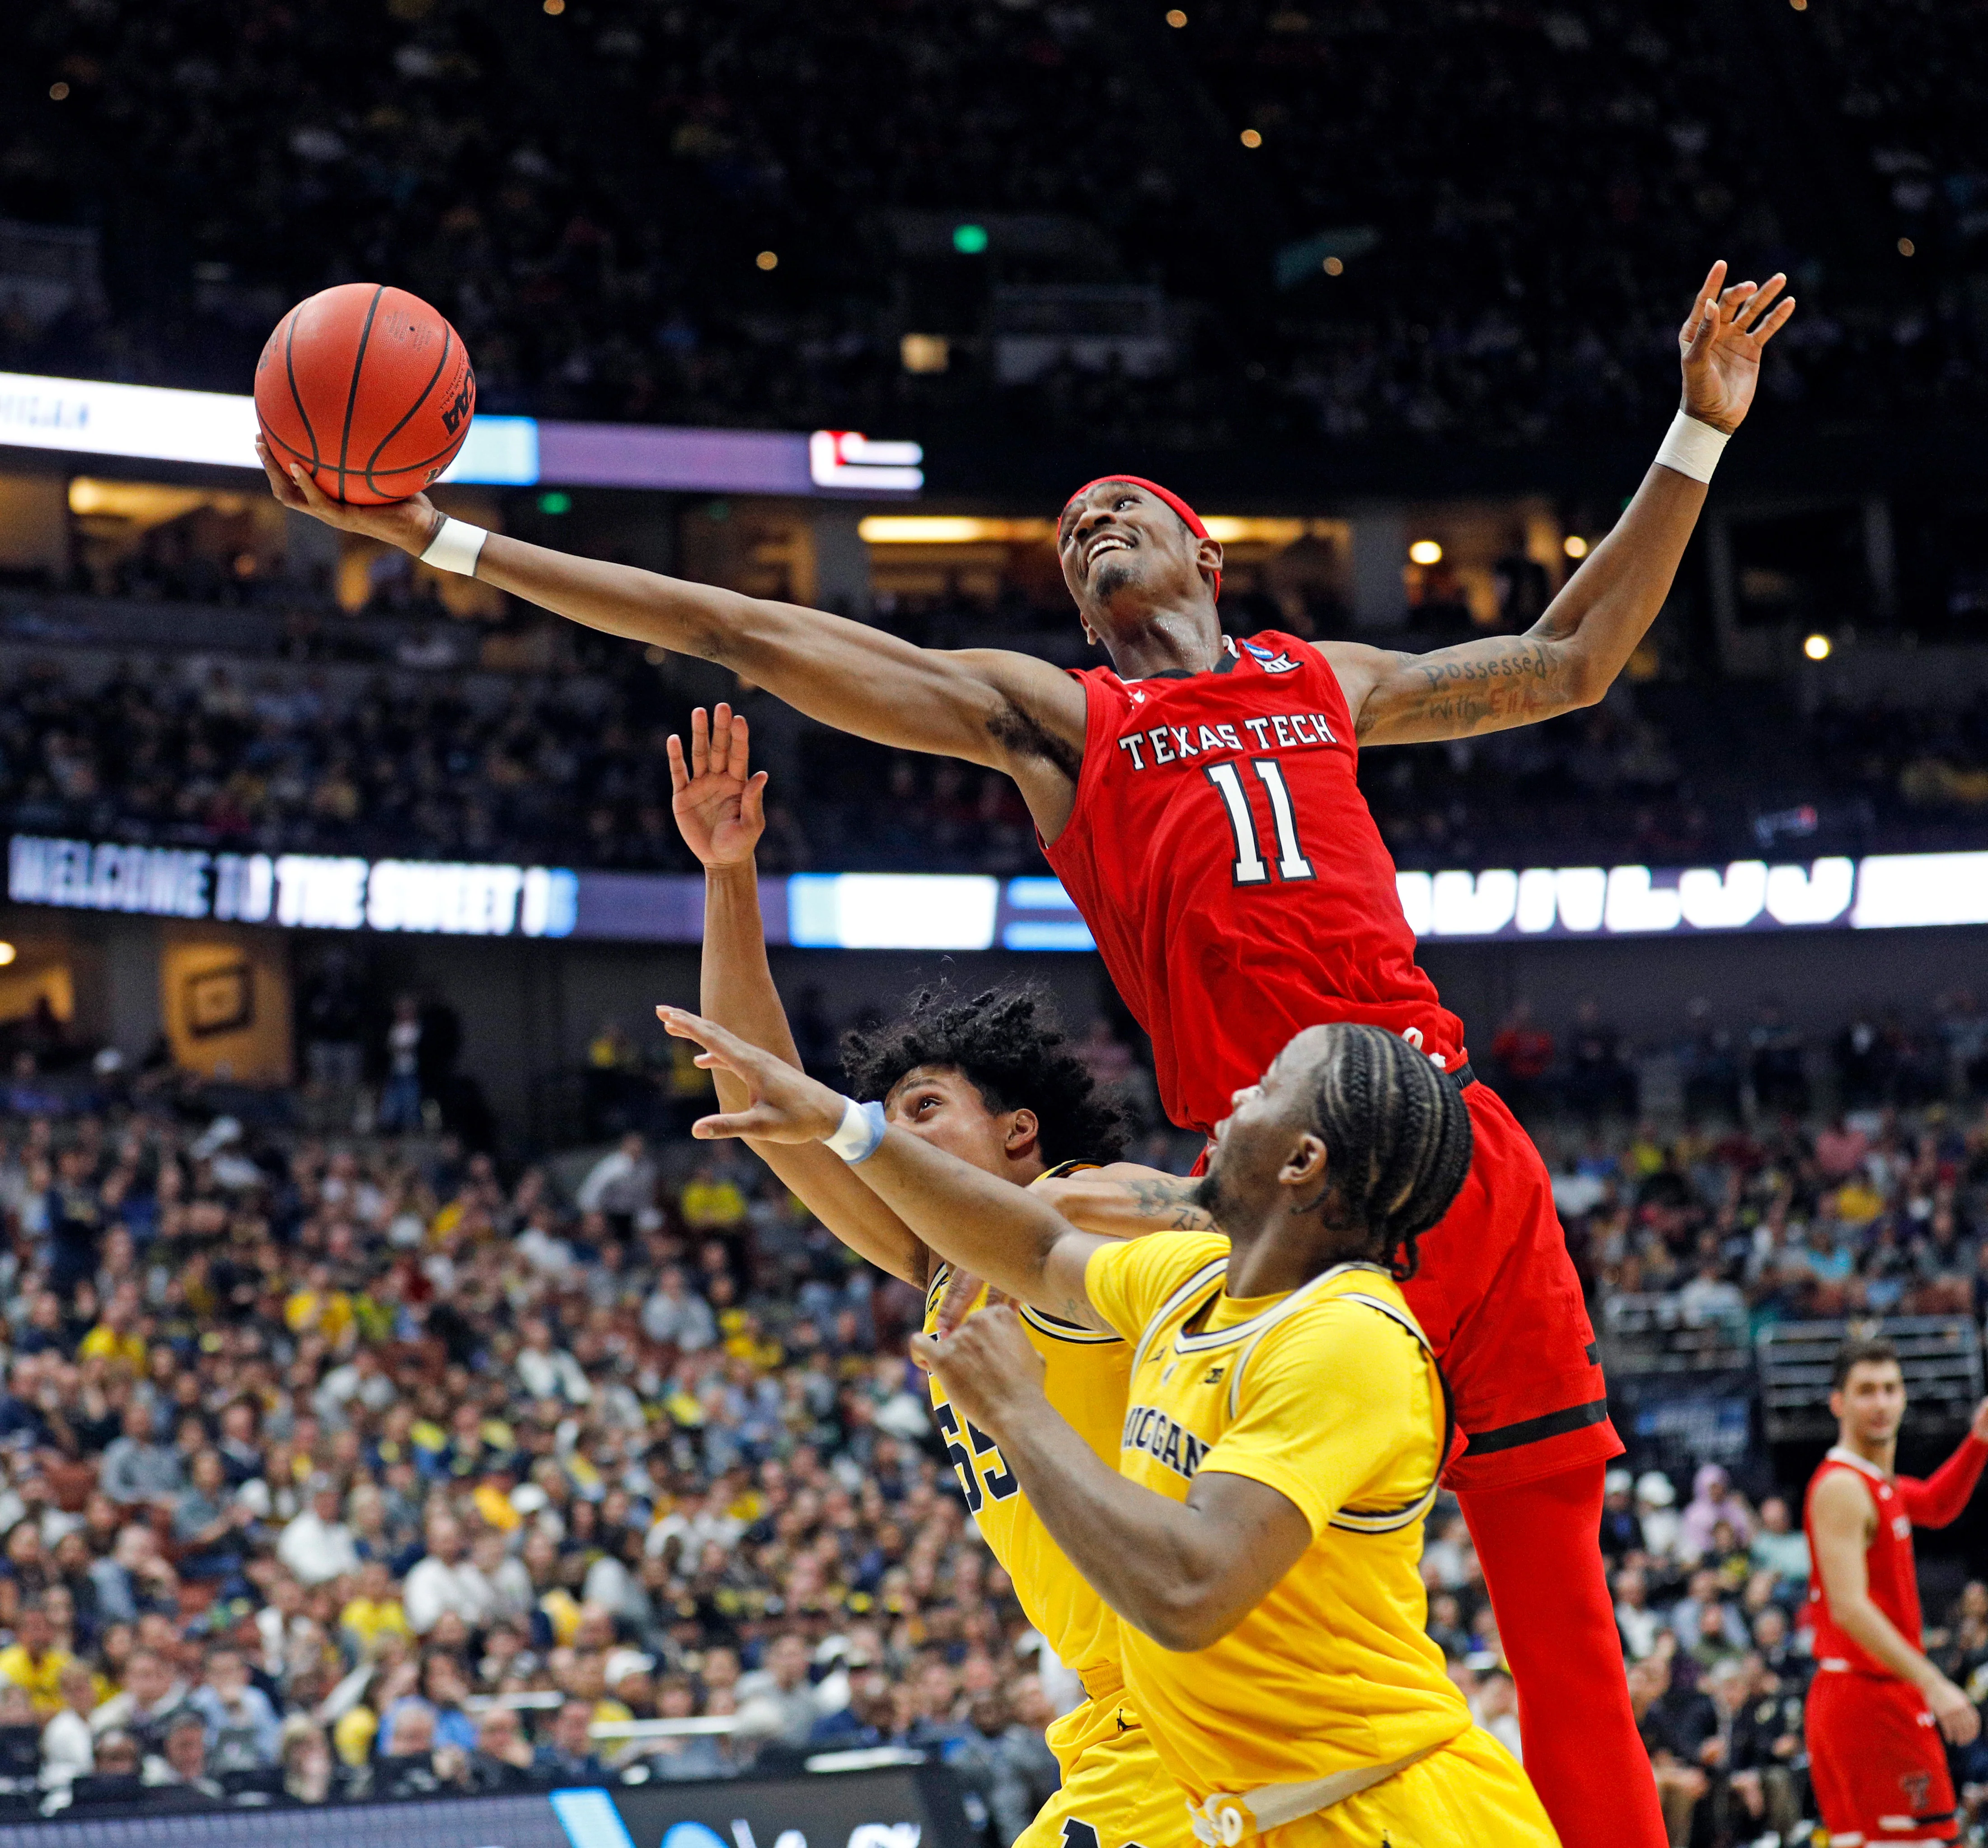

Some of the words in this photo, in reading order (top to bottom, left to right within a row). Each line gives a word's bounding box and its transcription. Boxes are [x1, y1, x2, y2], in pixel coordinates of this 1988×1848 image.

[441, 358, 475, 436] CAA
[1118, 724, 1244, 771] TEXAS
[1243, 714, 1337, 750] TECH
[1201, 758, 1318, 888] 11
[933, 1401, 1020, 1515] 55
